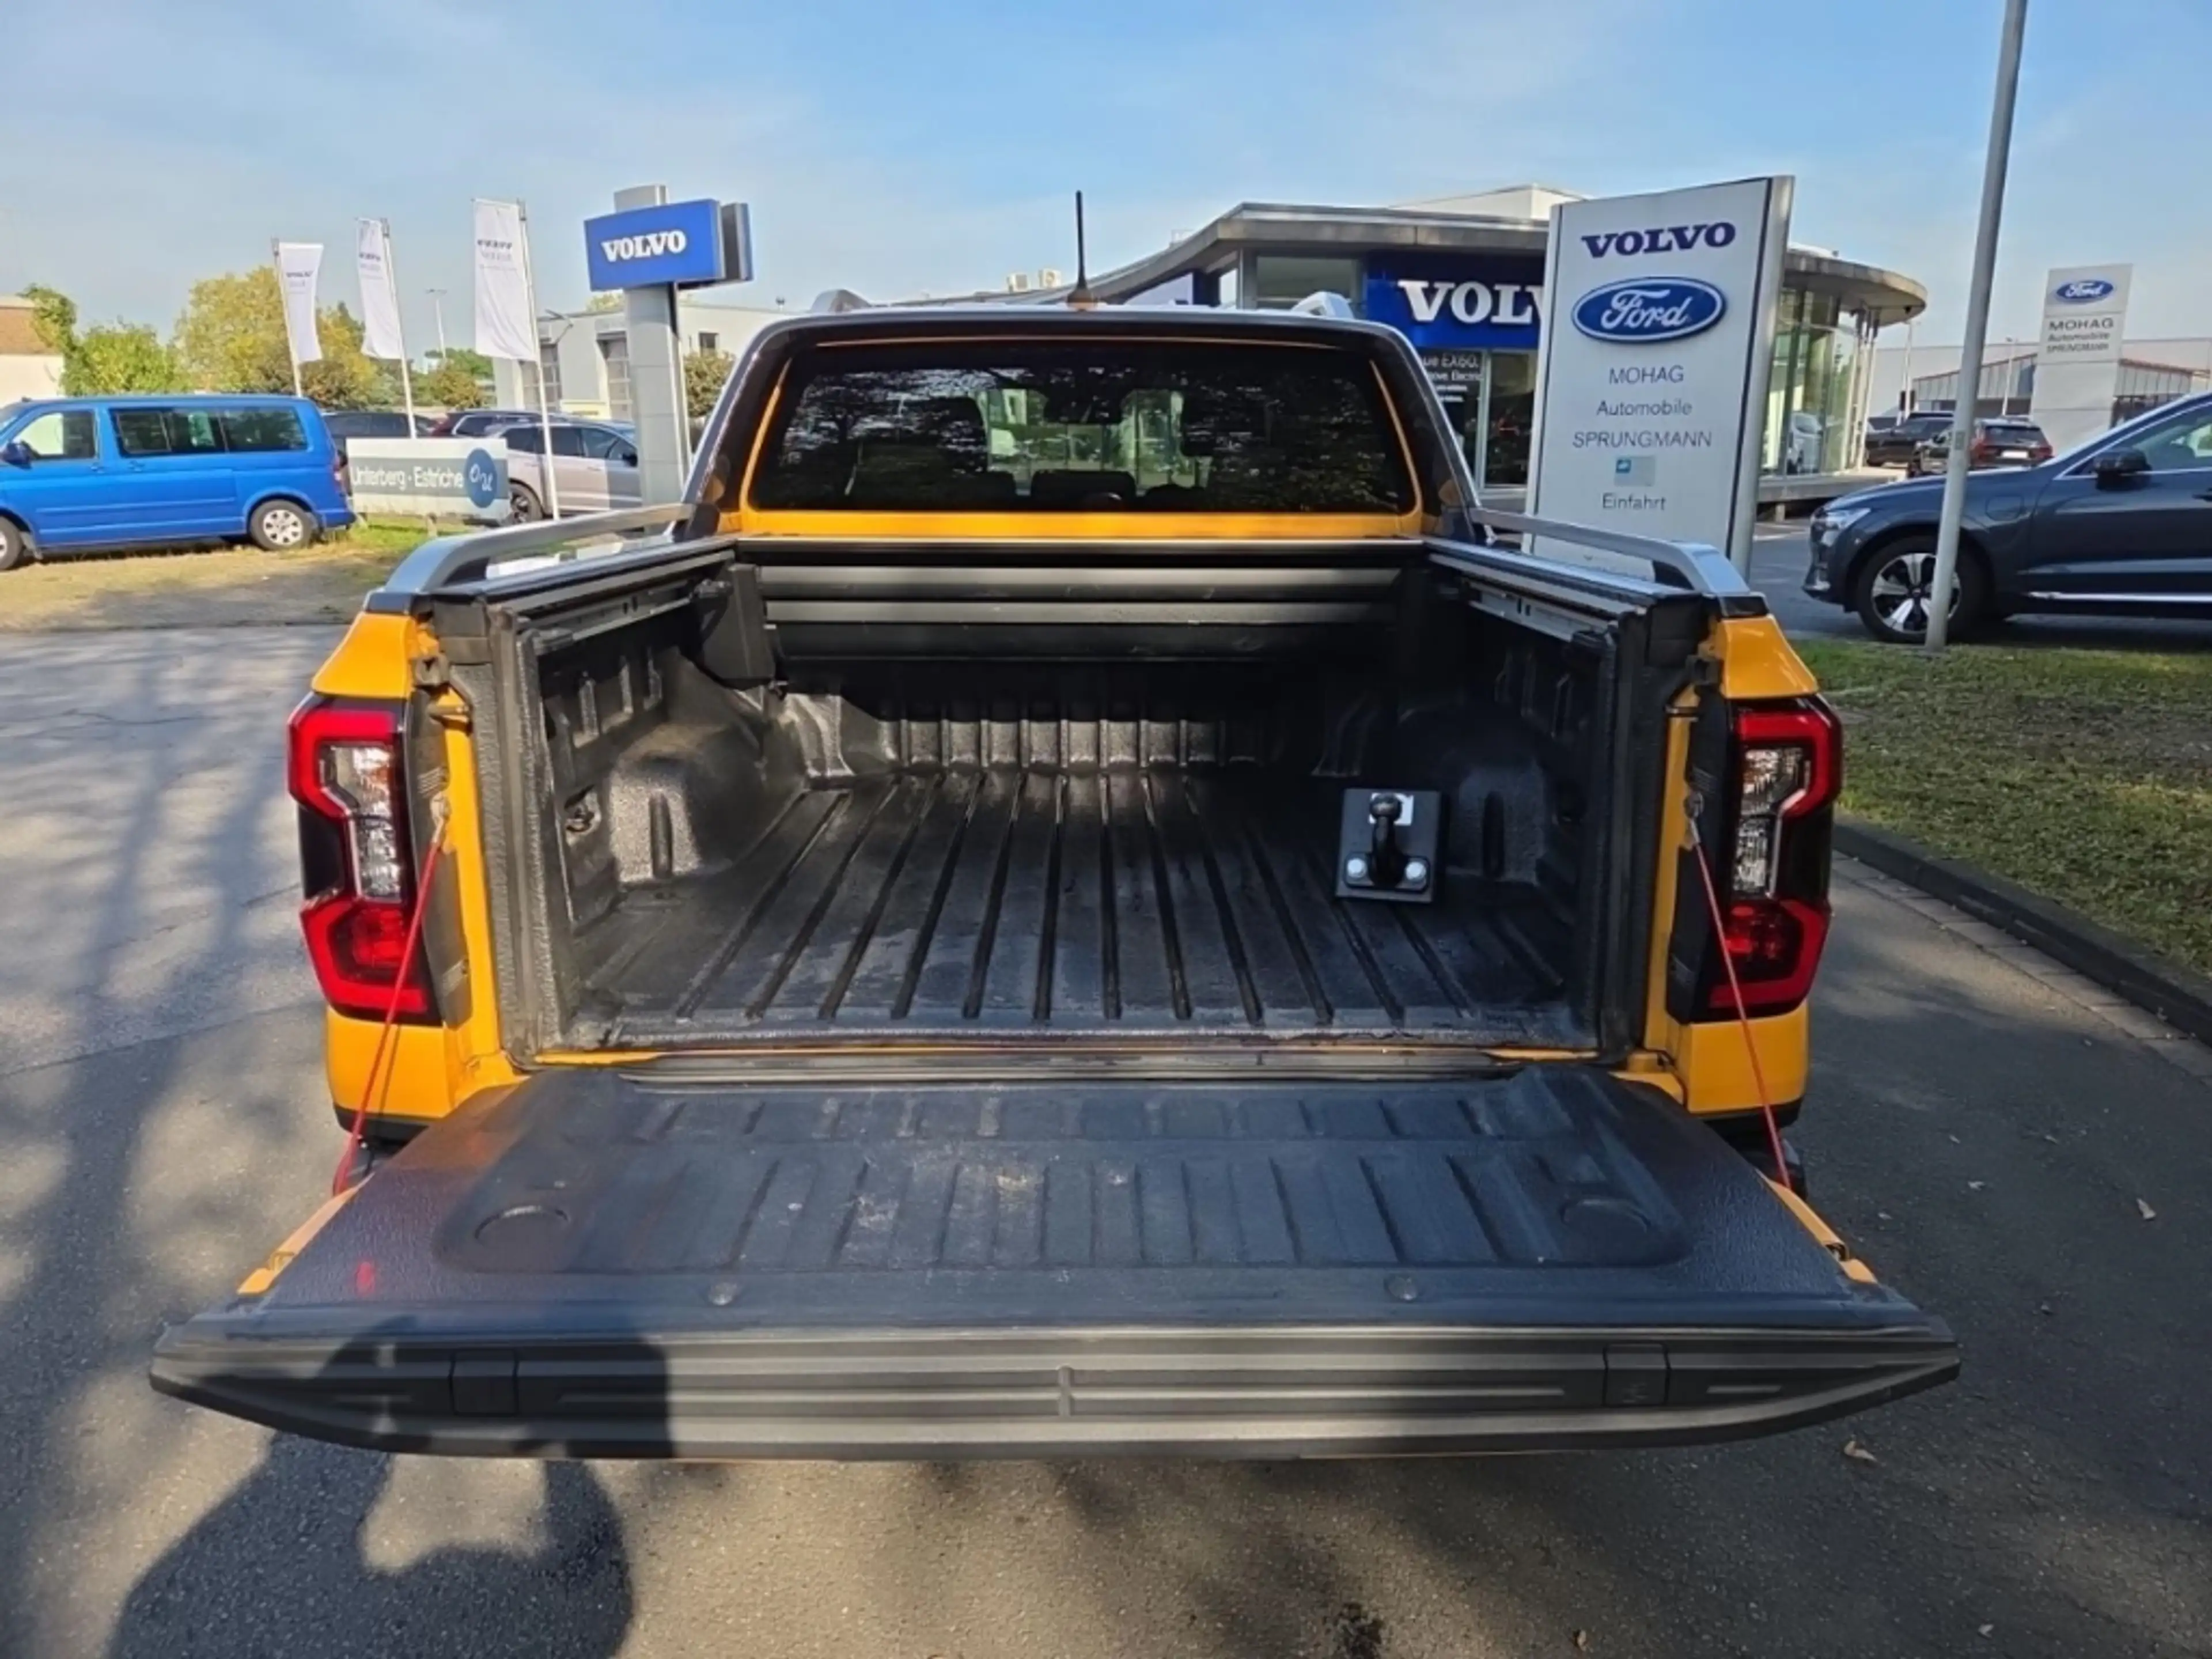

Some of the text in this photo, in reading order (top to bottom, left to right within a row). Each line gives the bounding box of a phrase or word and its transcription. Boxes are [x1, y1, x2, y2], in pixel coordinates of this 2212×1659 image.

[601, 229, 687, 262] VOLVO
[1581, 222, 1736, 259] VOLVO
[1600, 289, 1693, 329] Ford
[2049, 317, 2113, 331] MOHAG
[1609, 365, 1684, 384] MOHAG
[1596, 399, 1692, 416] Automobile
[1572, 431, 1712, 448] SPRUNGMANN
[413, 465, 464, 488] Estriche
[1602, 493, 1666, 510] Einfahrt
